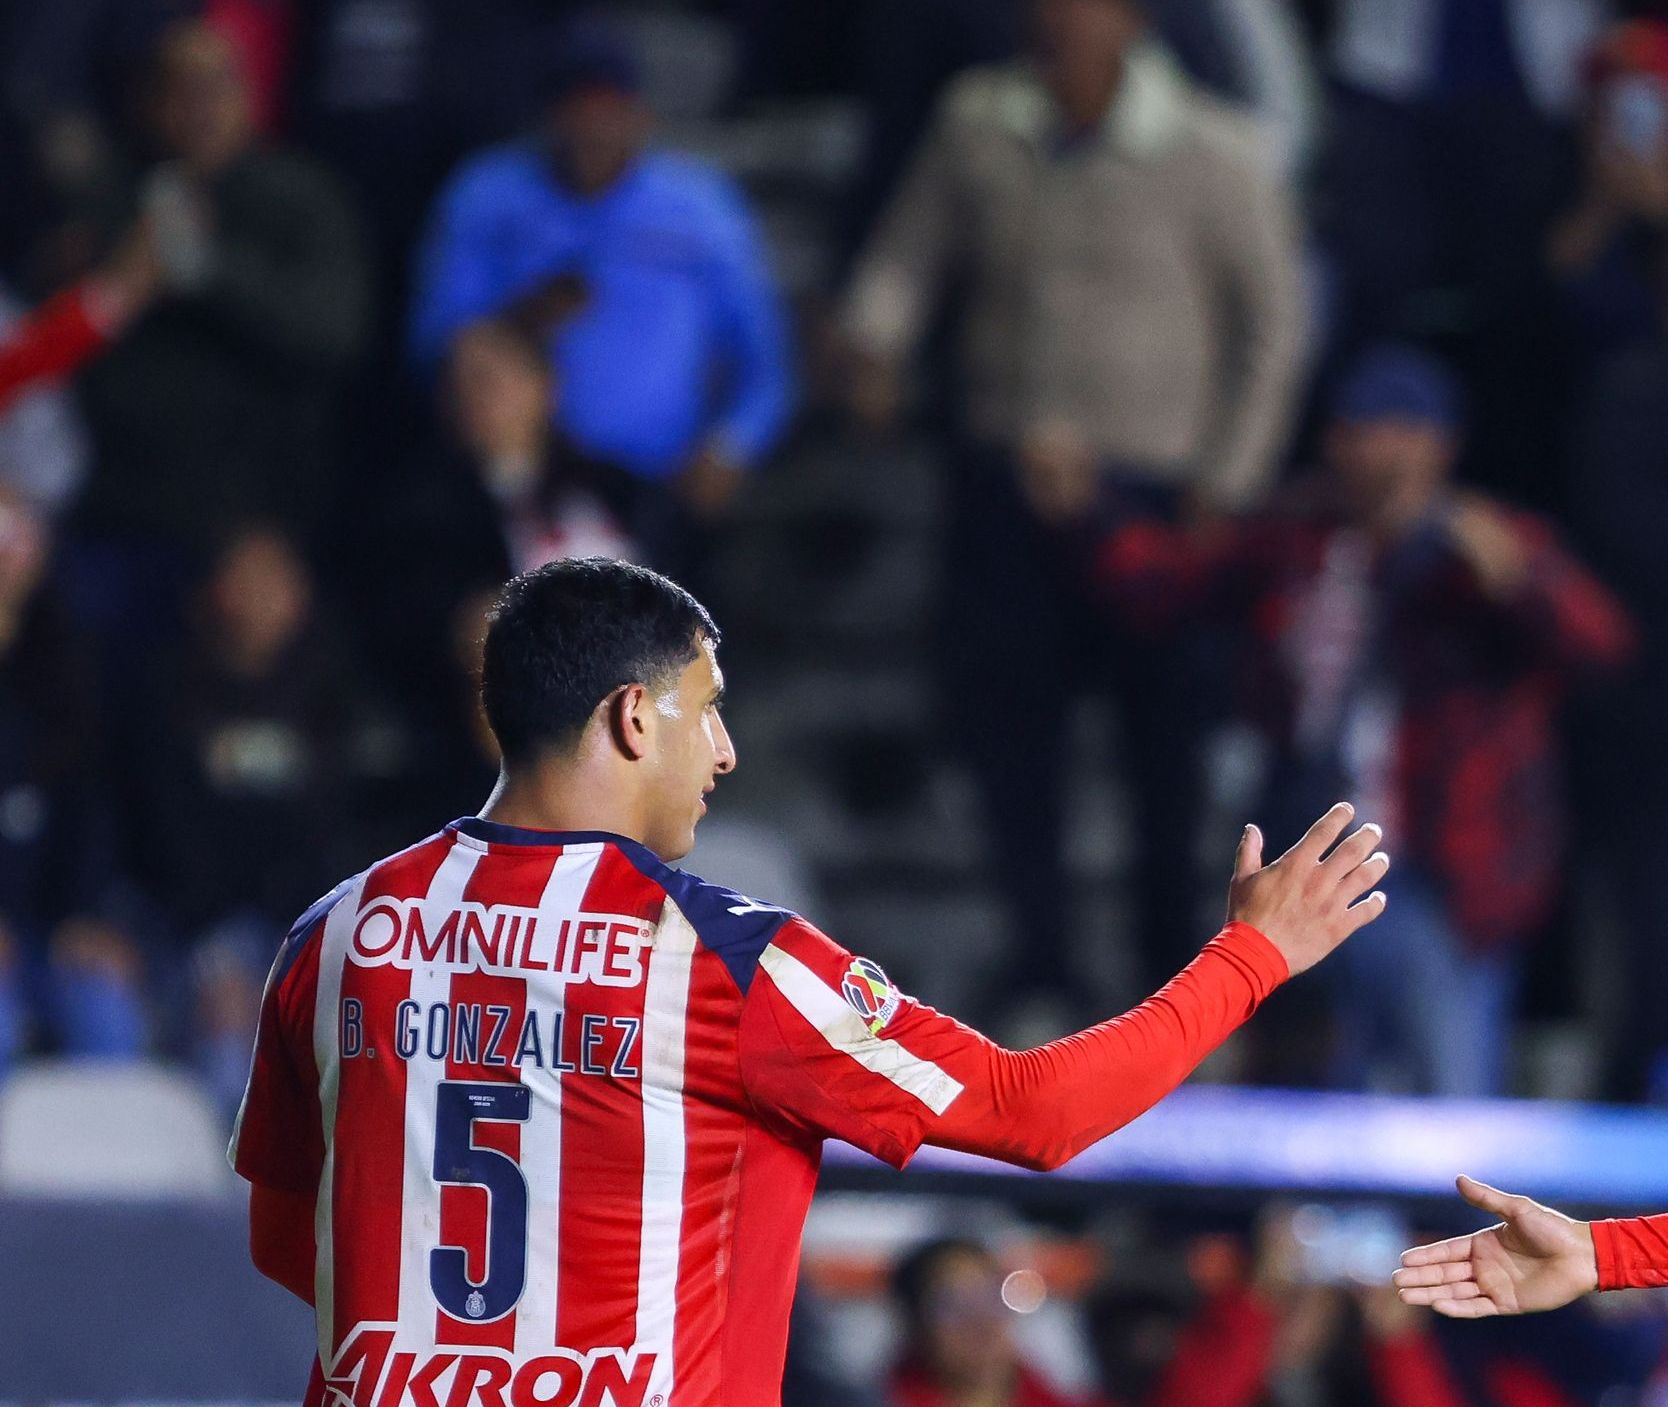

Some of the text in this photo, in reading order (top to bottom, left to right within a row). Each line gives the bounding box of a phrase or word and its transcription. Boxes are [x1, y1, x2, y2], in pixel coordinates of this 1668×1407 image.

[353, 903, 641, 978] OMNILIFE
[342, 998, 640, 1078] B. GONZALEZ
[430, 1079, 530, 1324] 5
